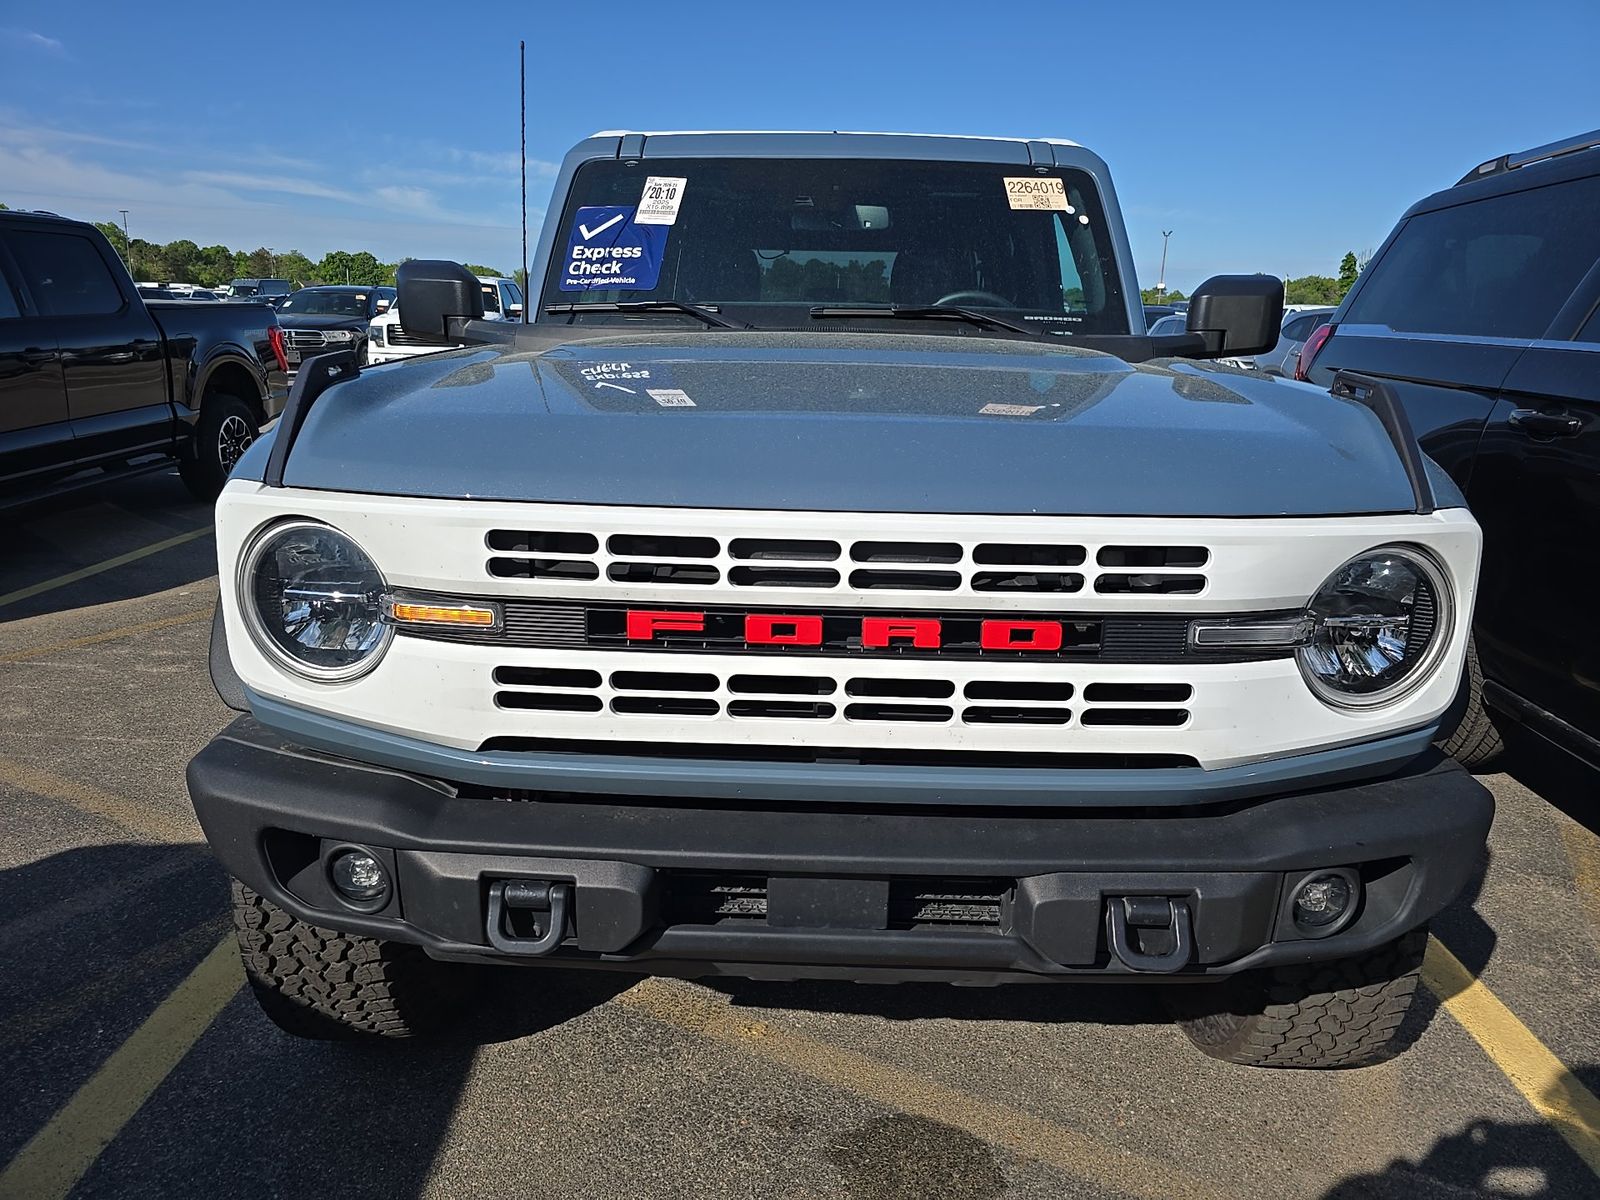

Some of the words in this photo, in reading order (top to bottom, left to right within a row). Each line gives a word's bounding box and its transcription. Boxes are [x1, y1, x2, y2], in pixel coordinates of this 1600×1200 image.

[649, 187, 676, 200] 20:10
[1007, 181, 1064, 195] 2264019
[572, 246, 642, 260] Express
[568, 260, 623, 275] Check
[626, 609, 1063, 651] FORD
